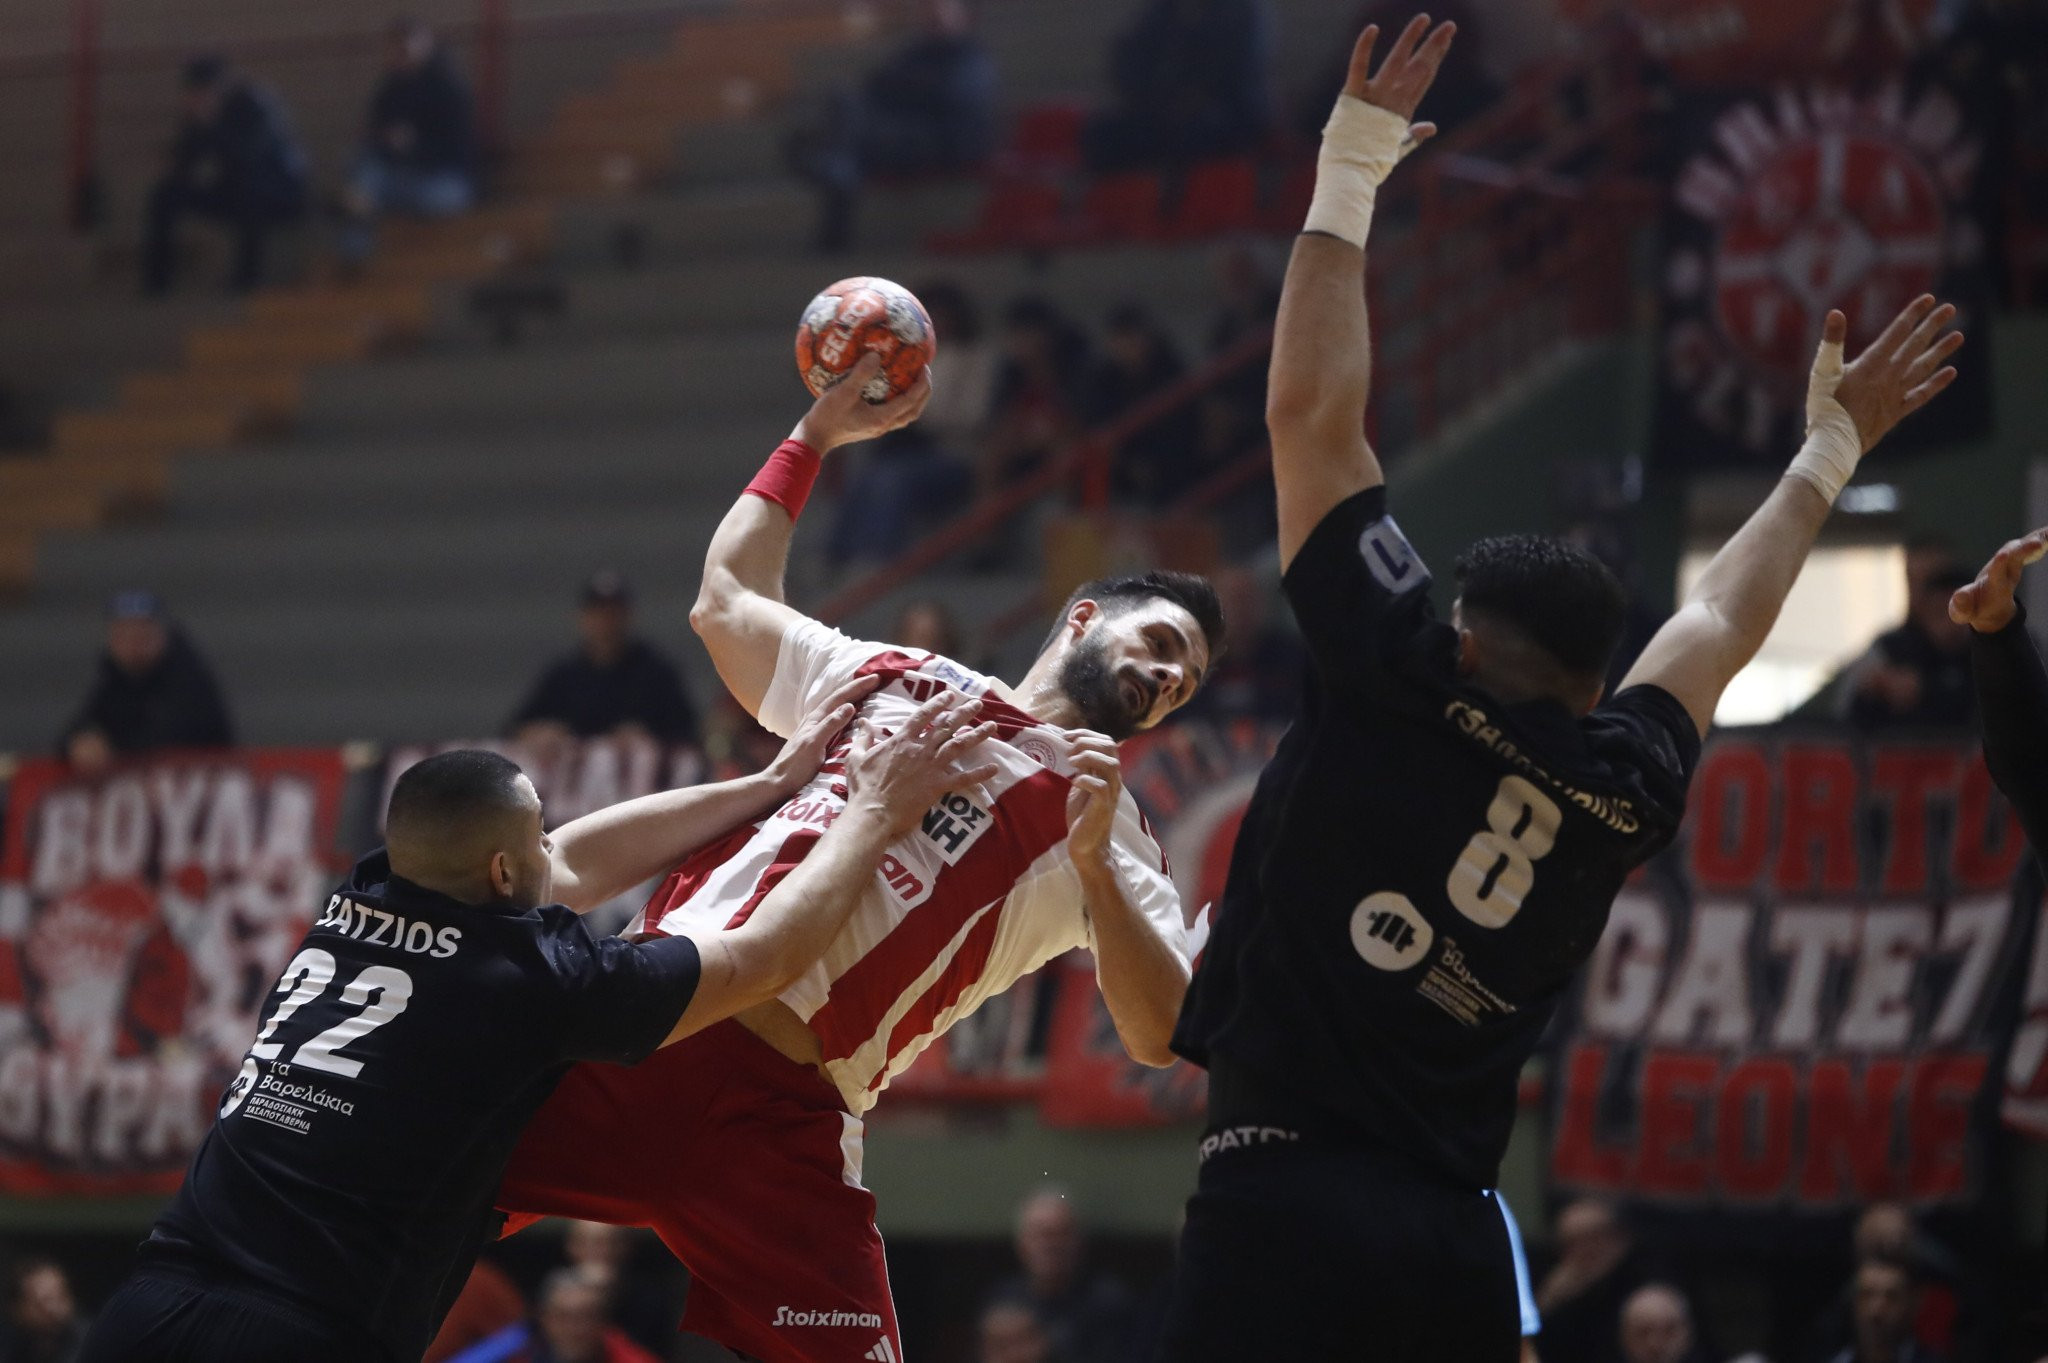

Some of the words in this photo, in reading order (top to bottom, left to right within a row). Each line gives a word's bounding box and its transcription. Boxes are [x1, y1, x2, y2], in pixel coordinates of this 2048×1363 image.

[1447, 775, 1563, 930] 8
[1630, 742, 2028, 890] ORTO
[315, 894, 463, 958] BATZIOS
[250, 947, 413, 1078] 22
[249, 1096, 305, 1118] ΠΑΡΑΔΟΣΙΑΚΗ
[258, 1074, 355, 1116] Βαρελάκια
[1552, 1048, 1988, 1198] LEONE
[772, 1305, 881, 1328] Stoiximan
